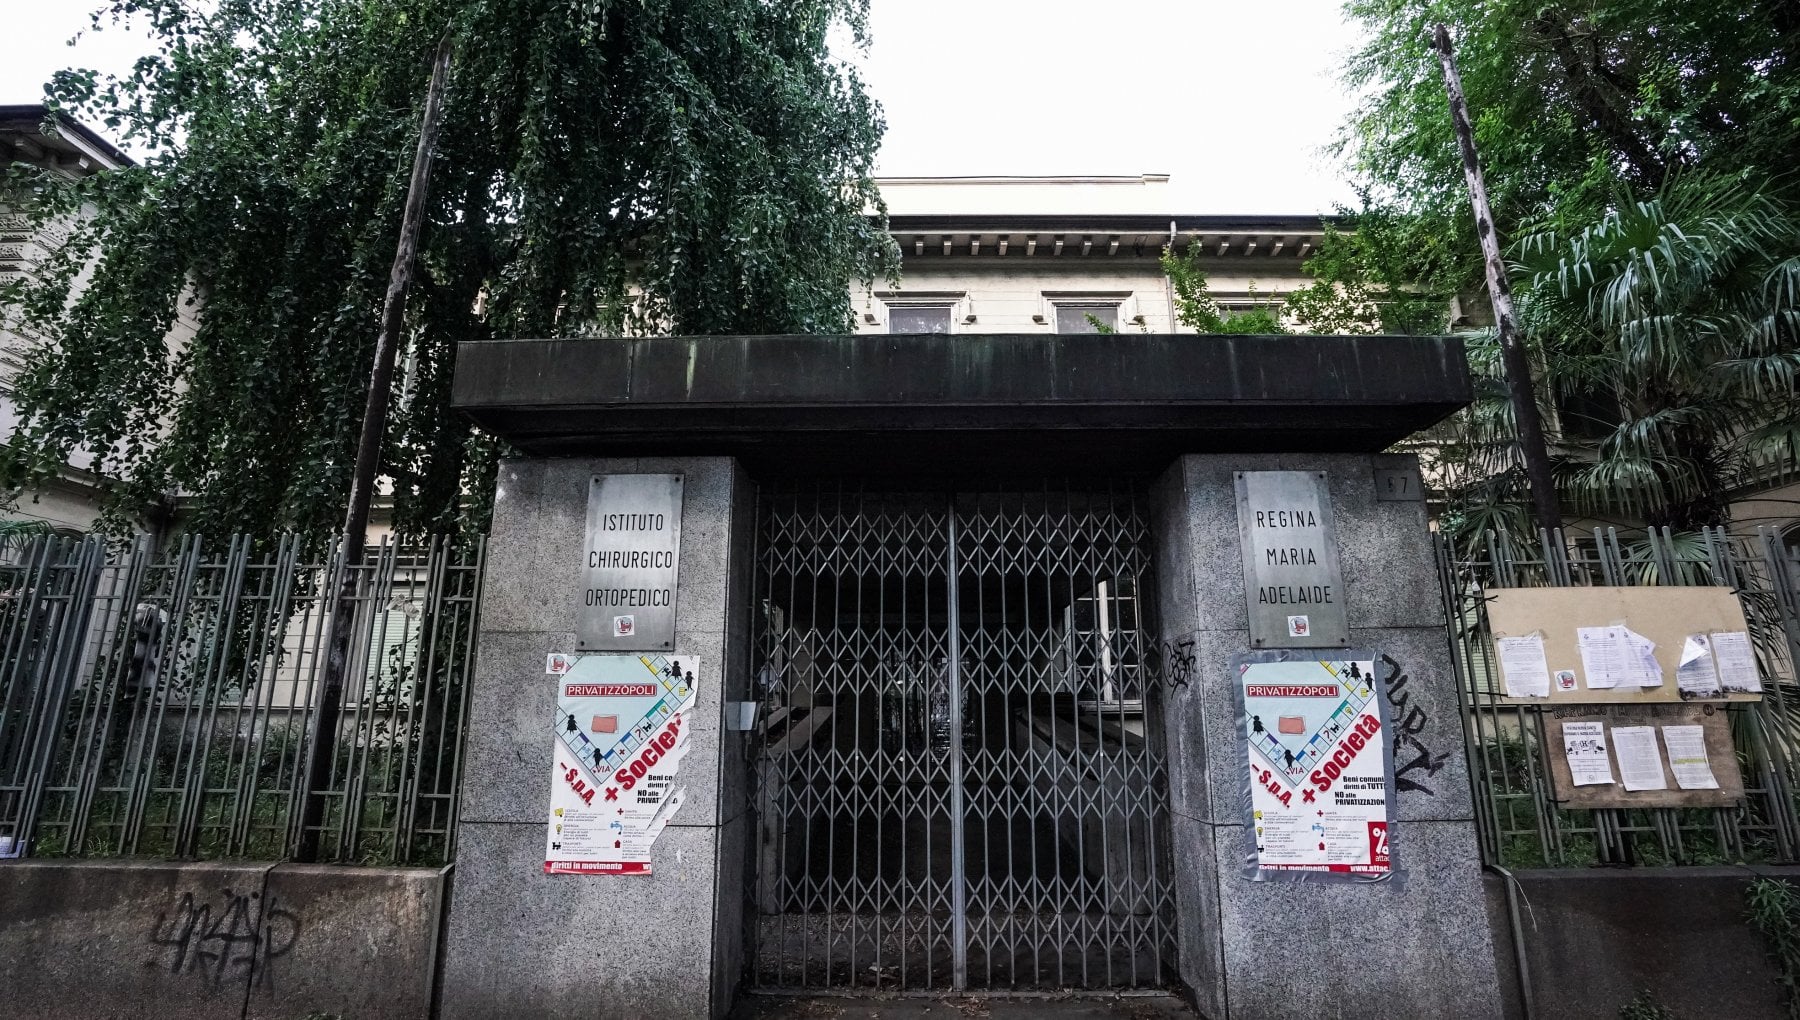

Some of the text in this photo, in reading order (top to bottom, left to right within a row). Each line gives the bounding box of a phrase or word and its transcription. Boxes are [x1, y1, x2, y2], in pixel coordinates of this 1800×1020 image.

[603, 513, 664, 531] ISTITUTO
[1256, 510, 1317, 528] REGINA
[588, 550, 673, 569] CHIRURGICO
[1266, 548, 1317, 566] MARIA
[585, 589, 671, 607] ORTOPEDICO
[1258, 586, 1333, 605] ADELAIDE
[614, 712, 682, 792] Societ
[1309, 713, 1382, 793] Società
[1343, 775, 1358, 783] Beni
[1367, 782, 1385, 790] TUTT
[637, 789, 647, 797] NO
[1335, 798, 1385, 806] PRIVATIZZAZION
[551, 861, 572, 869] diritti
[582, 862, 623, 870] movimento
[1350, 864, 1391, 872] www.attac.
